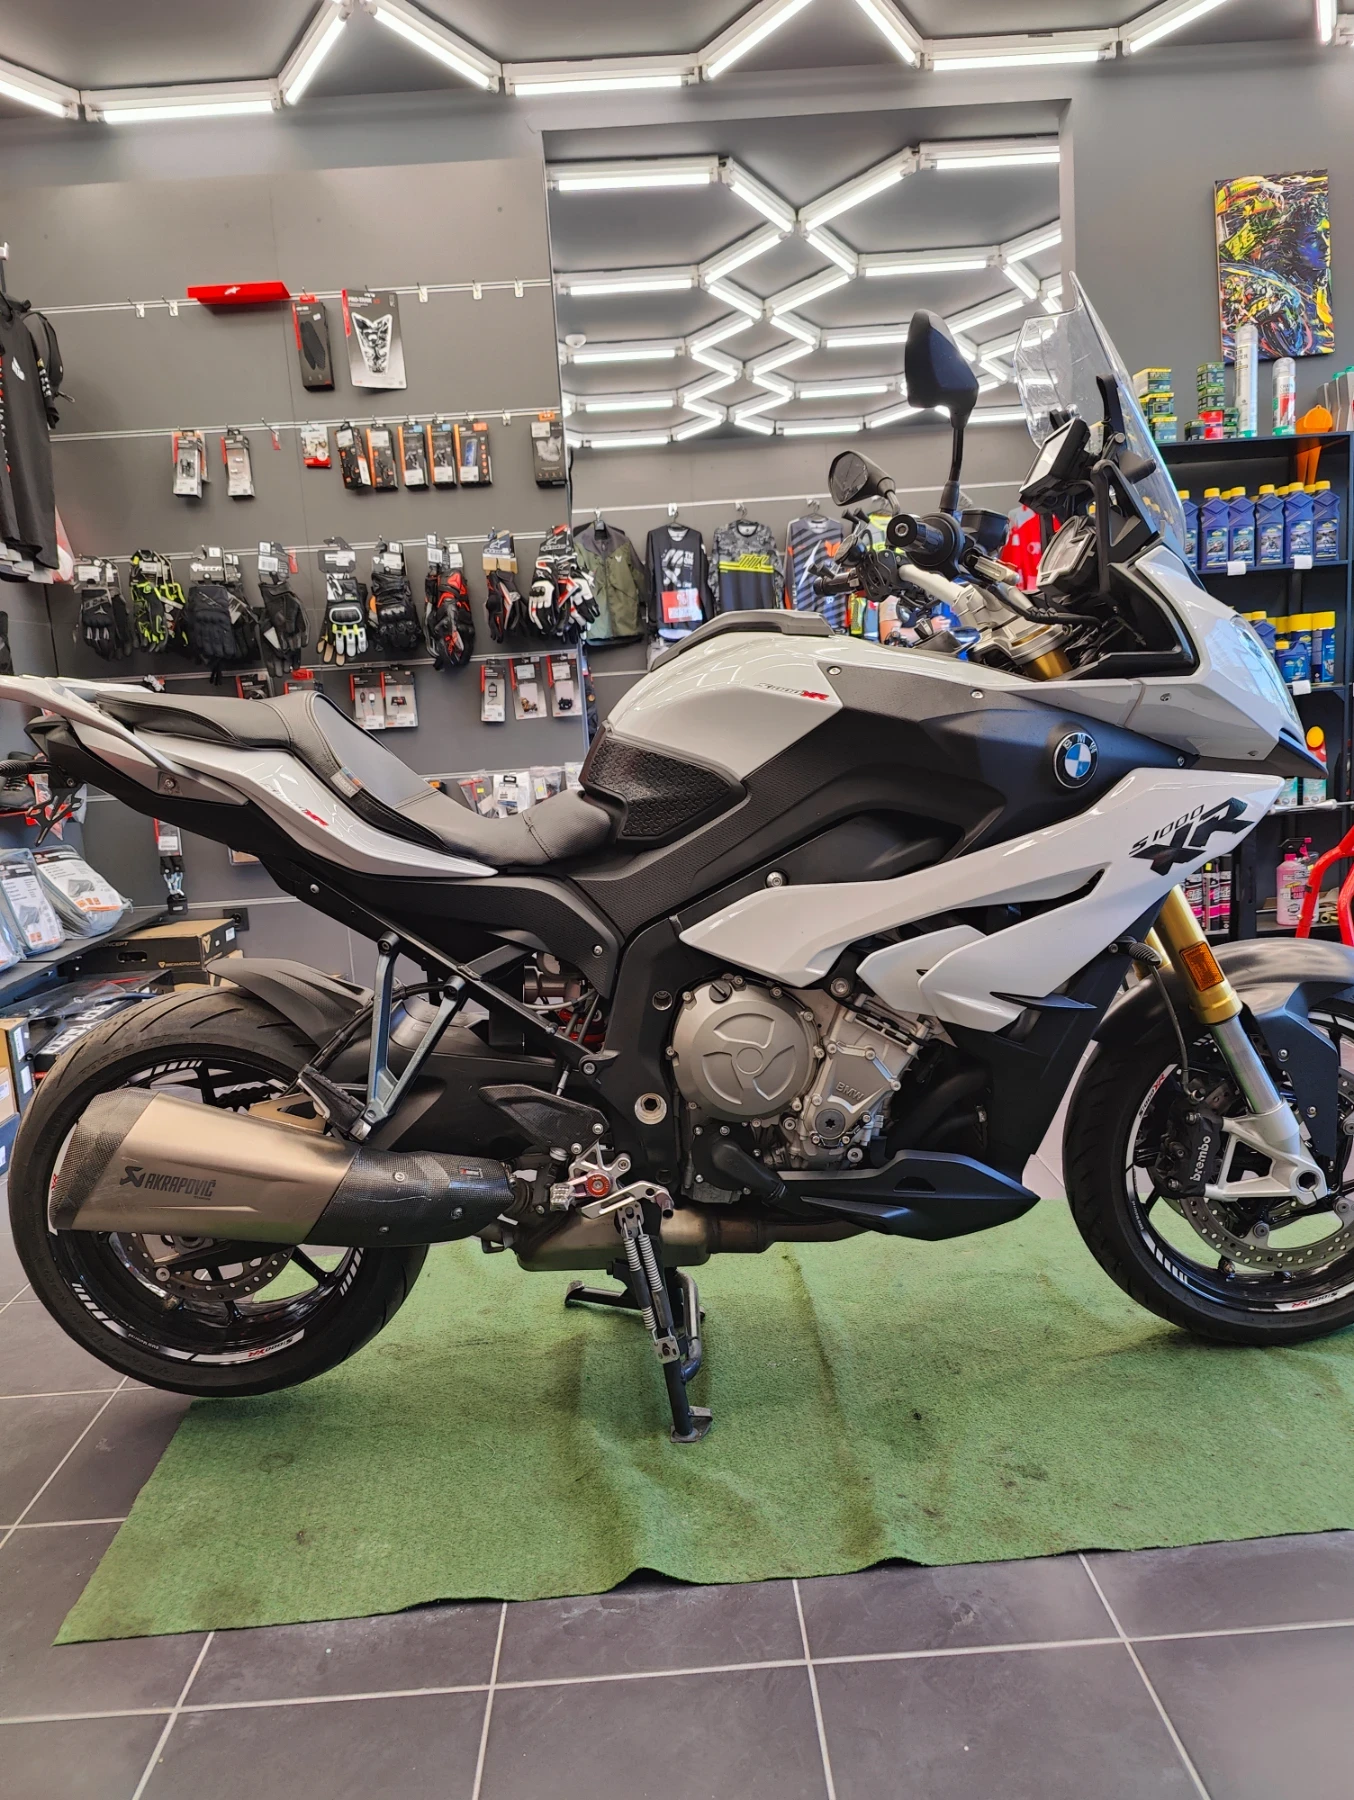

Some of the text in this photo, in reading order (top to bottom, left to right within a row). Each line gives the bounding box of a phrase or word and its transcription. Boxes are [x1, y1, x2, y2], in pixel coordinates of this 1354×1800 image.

[1062, 733, 1098, 754] BMW
[1128, 803, 1205, 856] S 1000
[1129, 797, 1256, 876] XR
[836, 1081, 865, 1101] BMW
[1190, 1135, 1212, 1182] brembo
